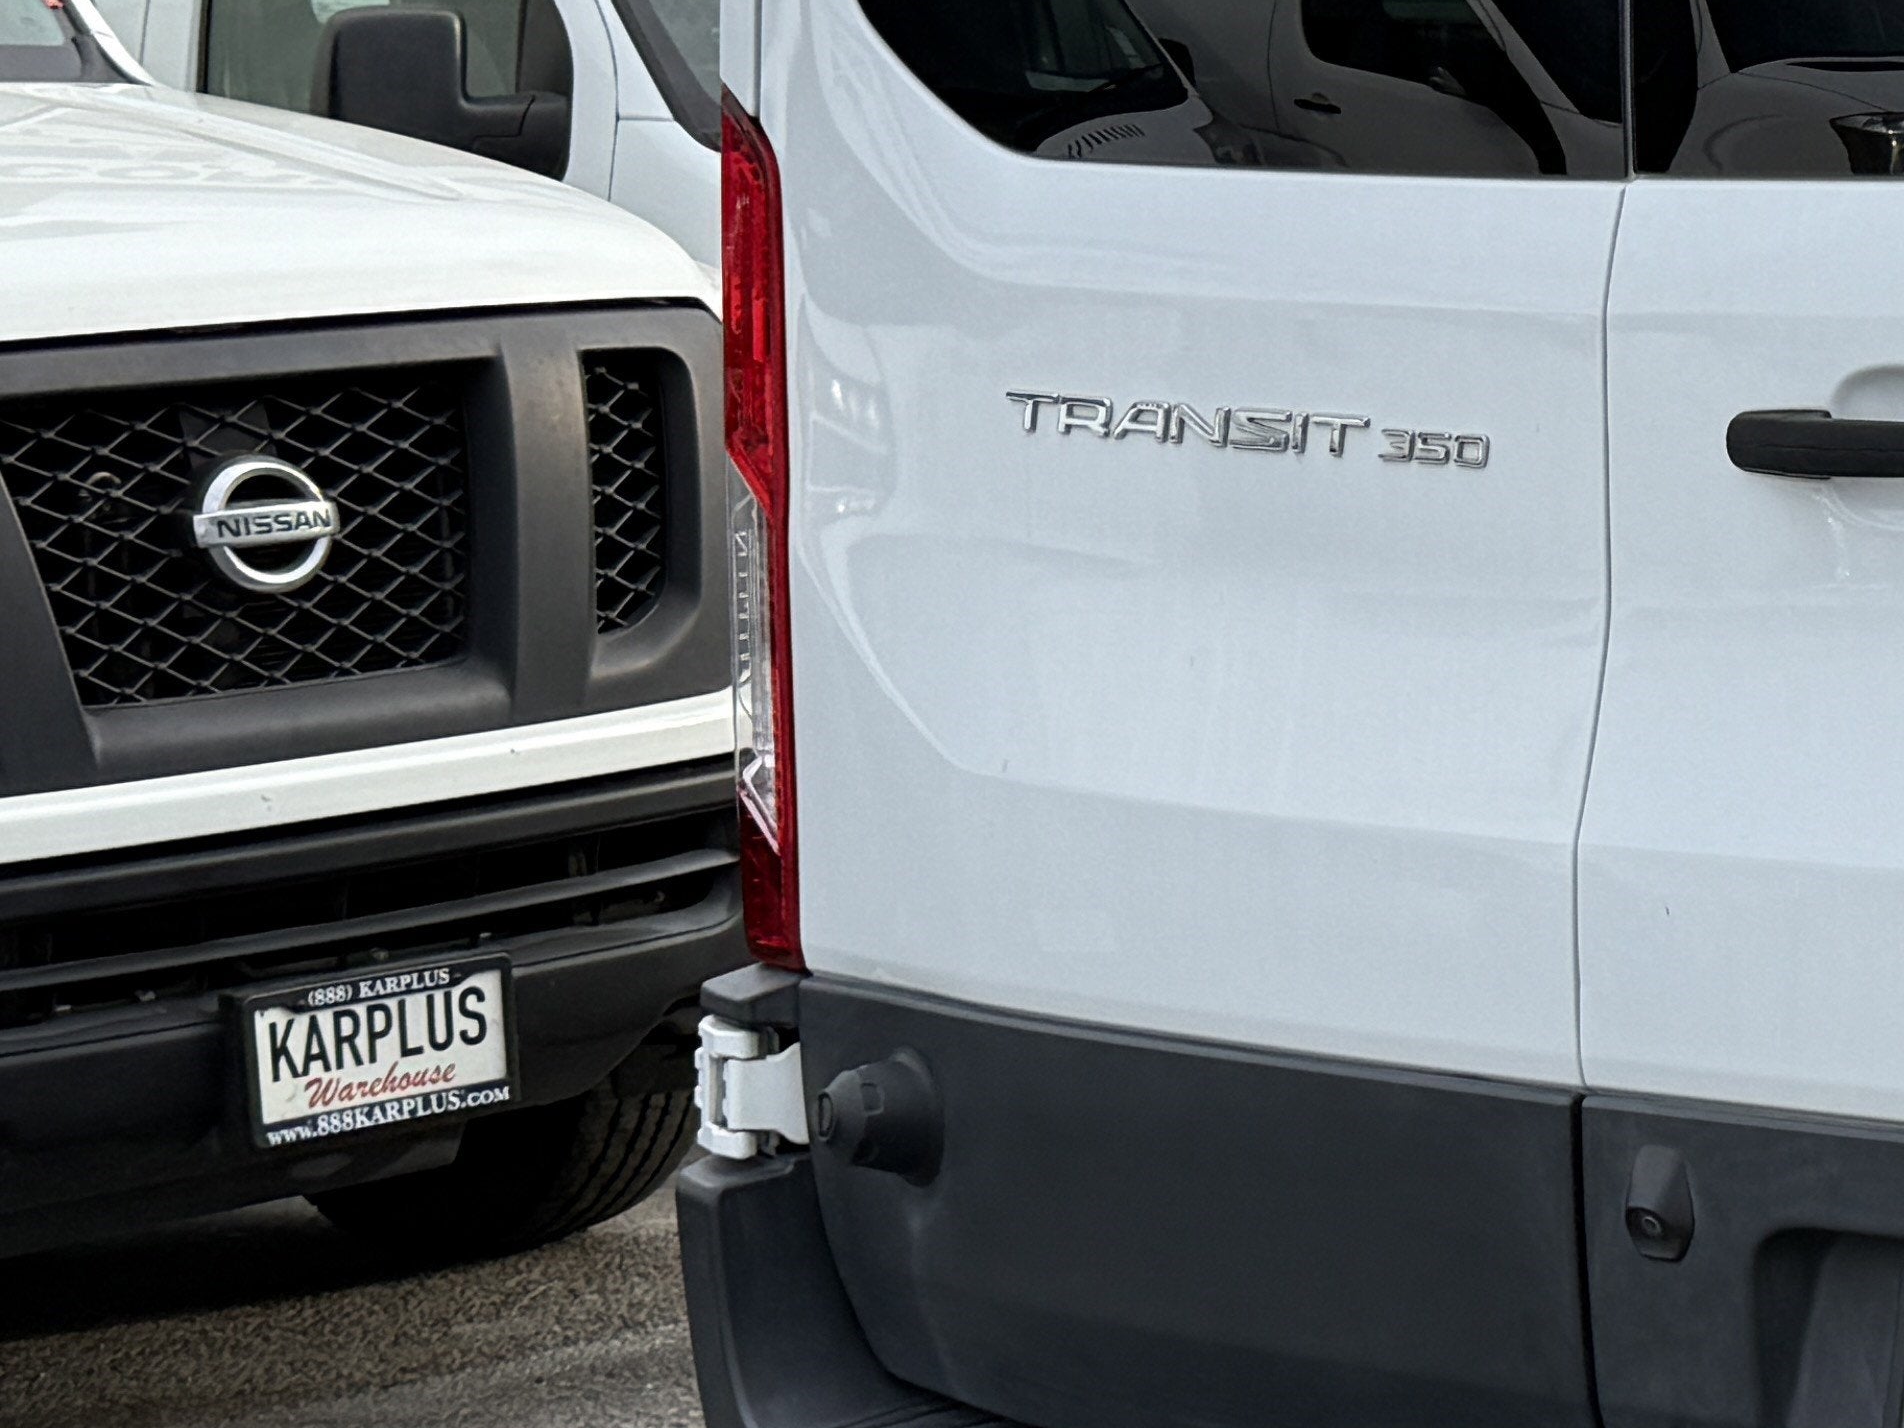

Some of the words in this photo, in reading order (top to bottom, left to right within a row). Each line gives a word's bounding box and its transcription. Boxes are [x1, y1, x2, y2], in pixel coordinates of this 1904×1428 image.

[1005, 390, 1371, 458] TRANSIT
[1378, 427, 1490, 469] 350
[217, 509, 331, 538] NISSAN
[307, 983, 352, 1007] (888)
[359, 968, 450, 998] KARPLUS
[268, 986, 487, 1083] KARPLUS
[303, 1061, 456, 1109] Warehouse
